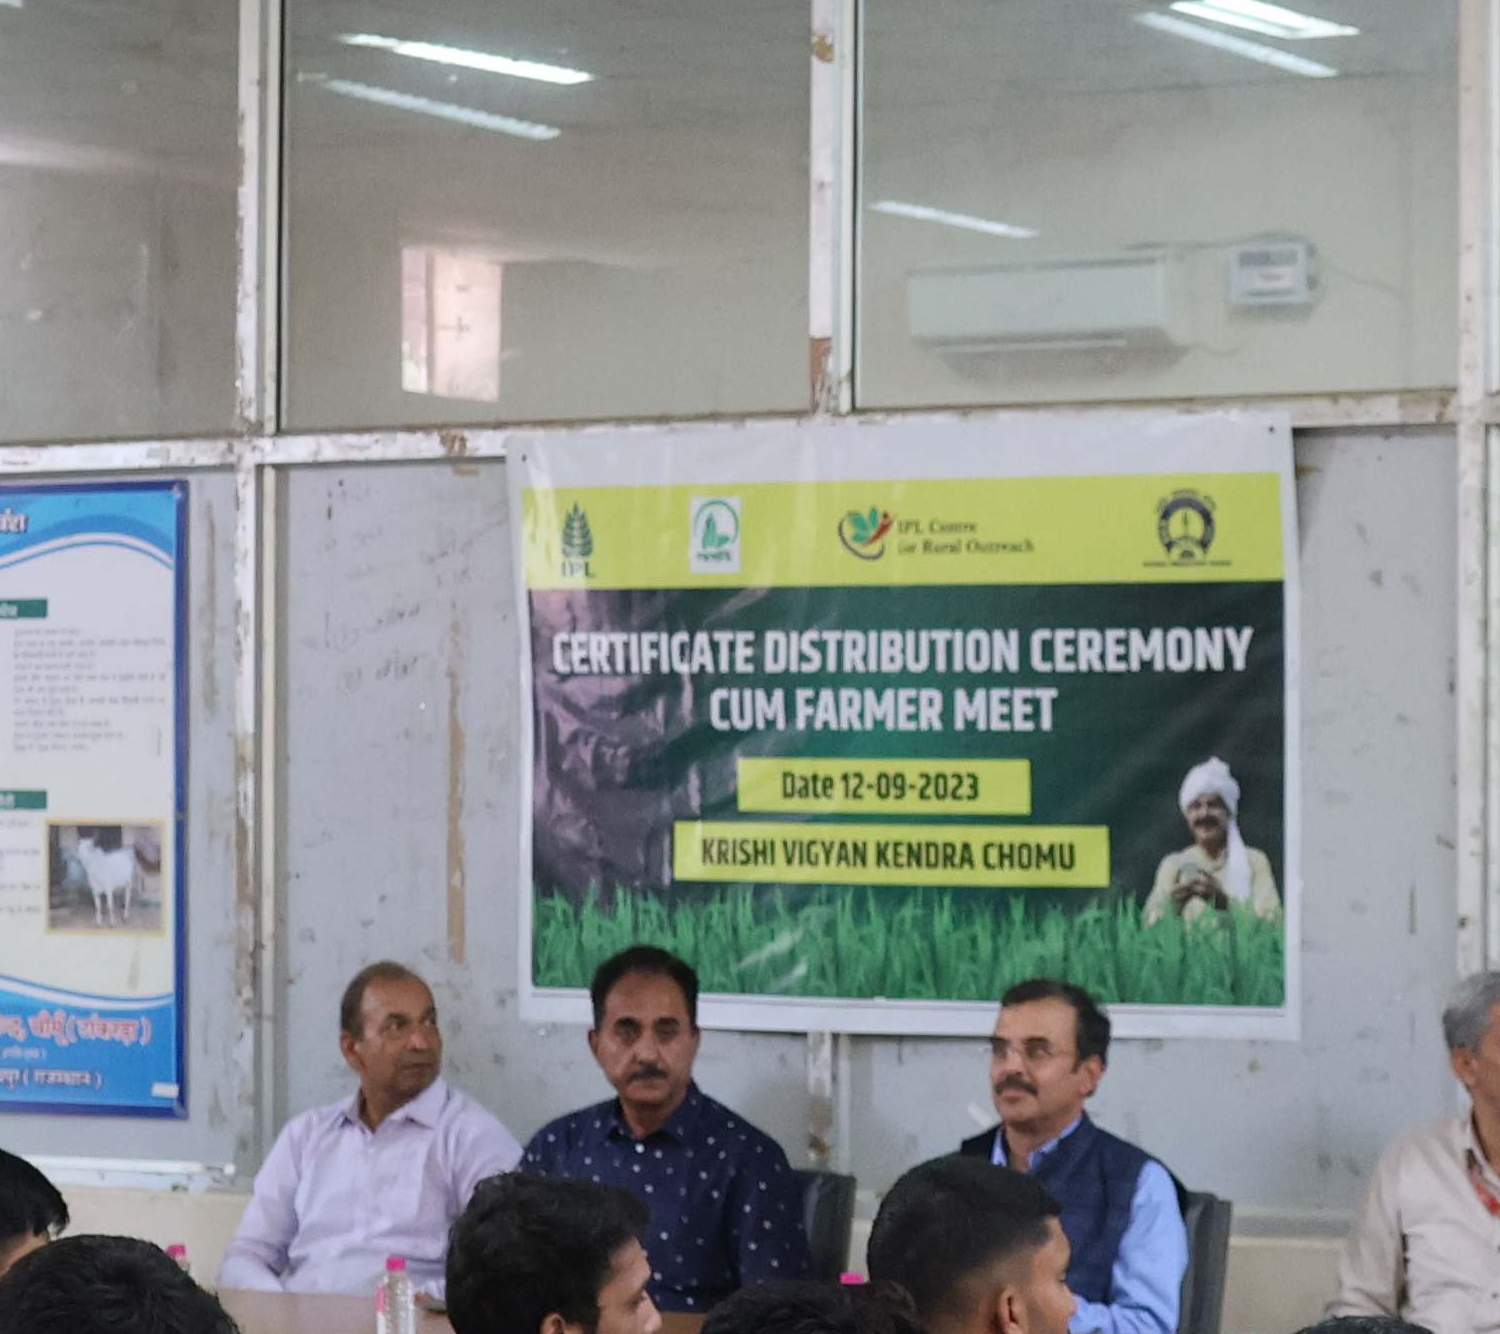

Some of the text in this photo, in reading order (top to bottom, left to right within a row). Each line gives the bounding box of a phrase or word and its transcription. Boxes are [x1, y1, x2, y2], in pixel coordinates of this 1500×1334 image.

[560, 560, 596, 579] IPL
[551, 625, 1254, 675] CERTIFICATE DISTRIBUTION CEREMONY
[709, 686, 1059, 732] CUM FARMER MEET
[781, 771, 980, 801] Date 12-09-2023
[701, 837, 1077, 871] KRISHI VIGYAN KENDRA CHOMU
